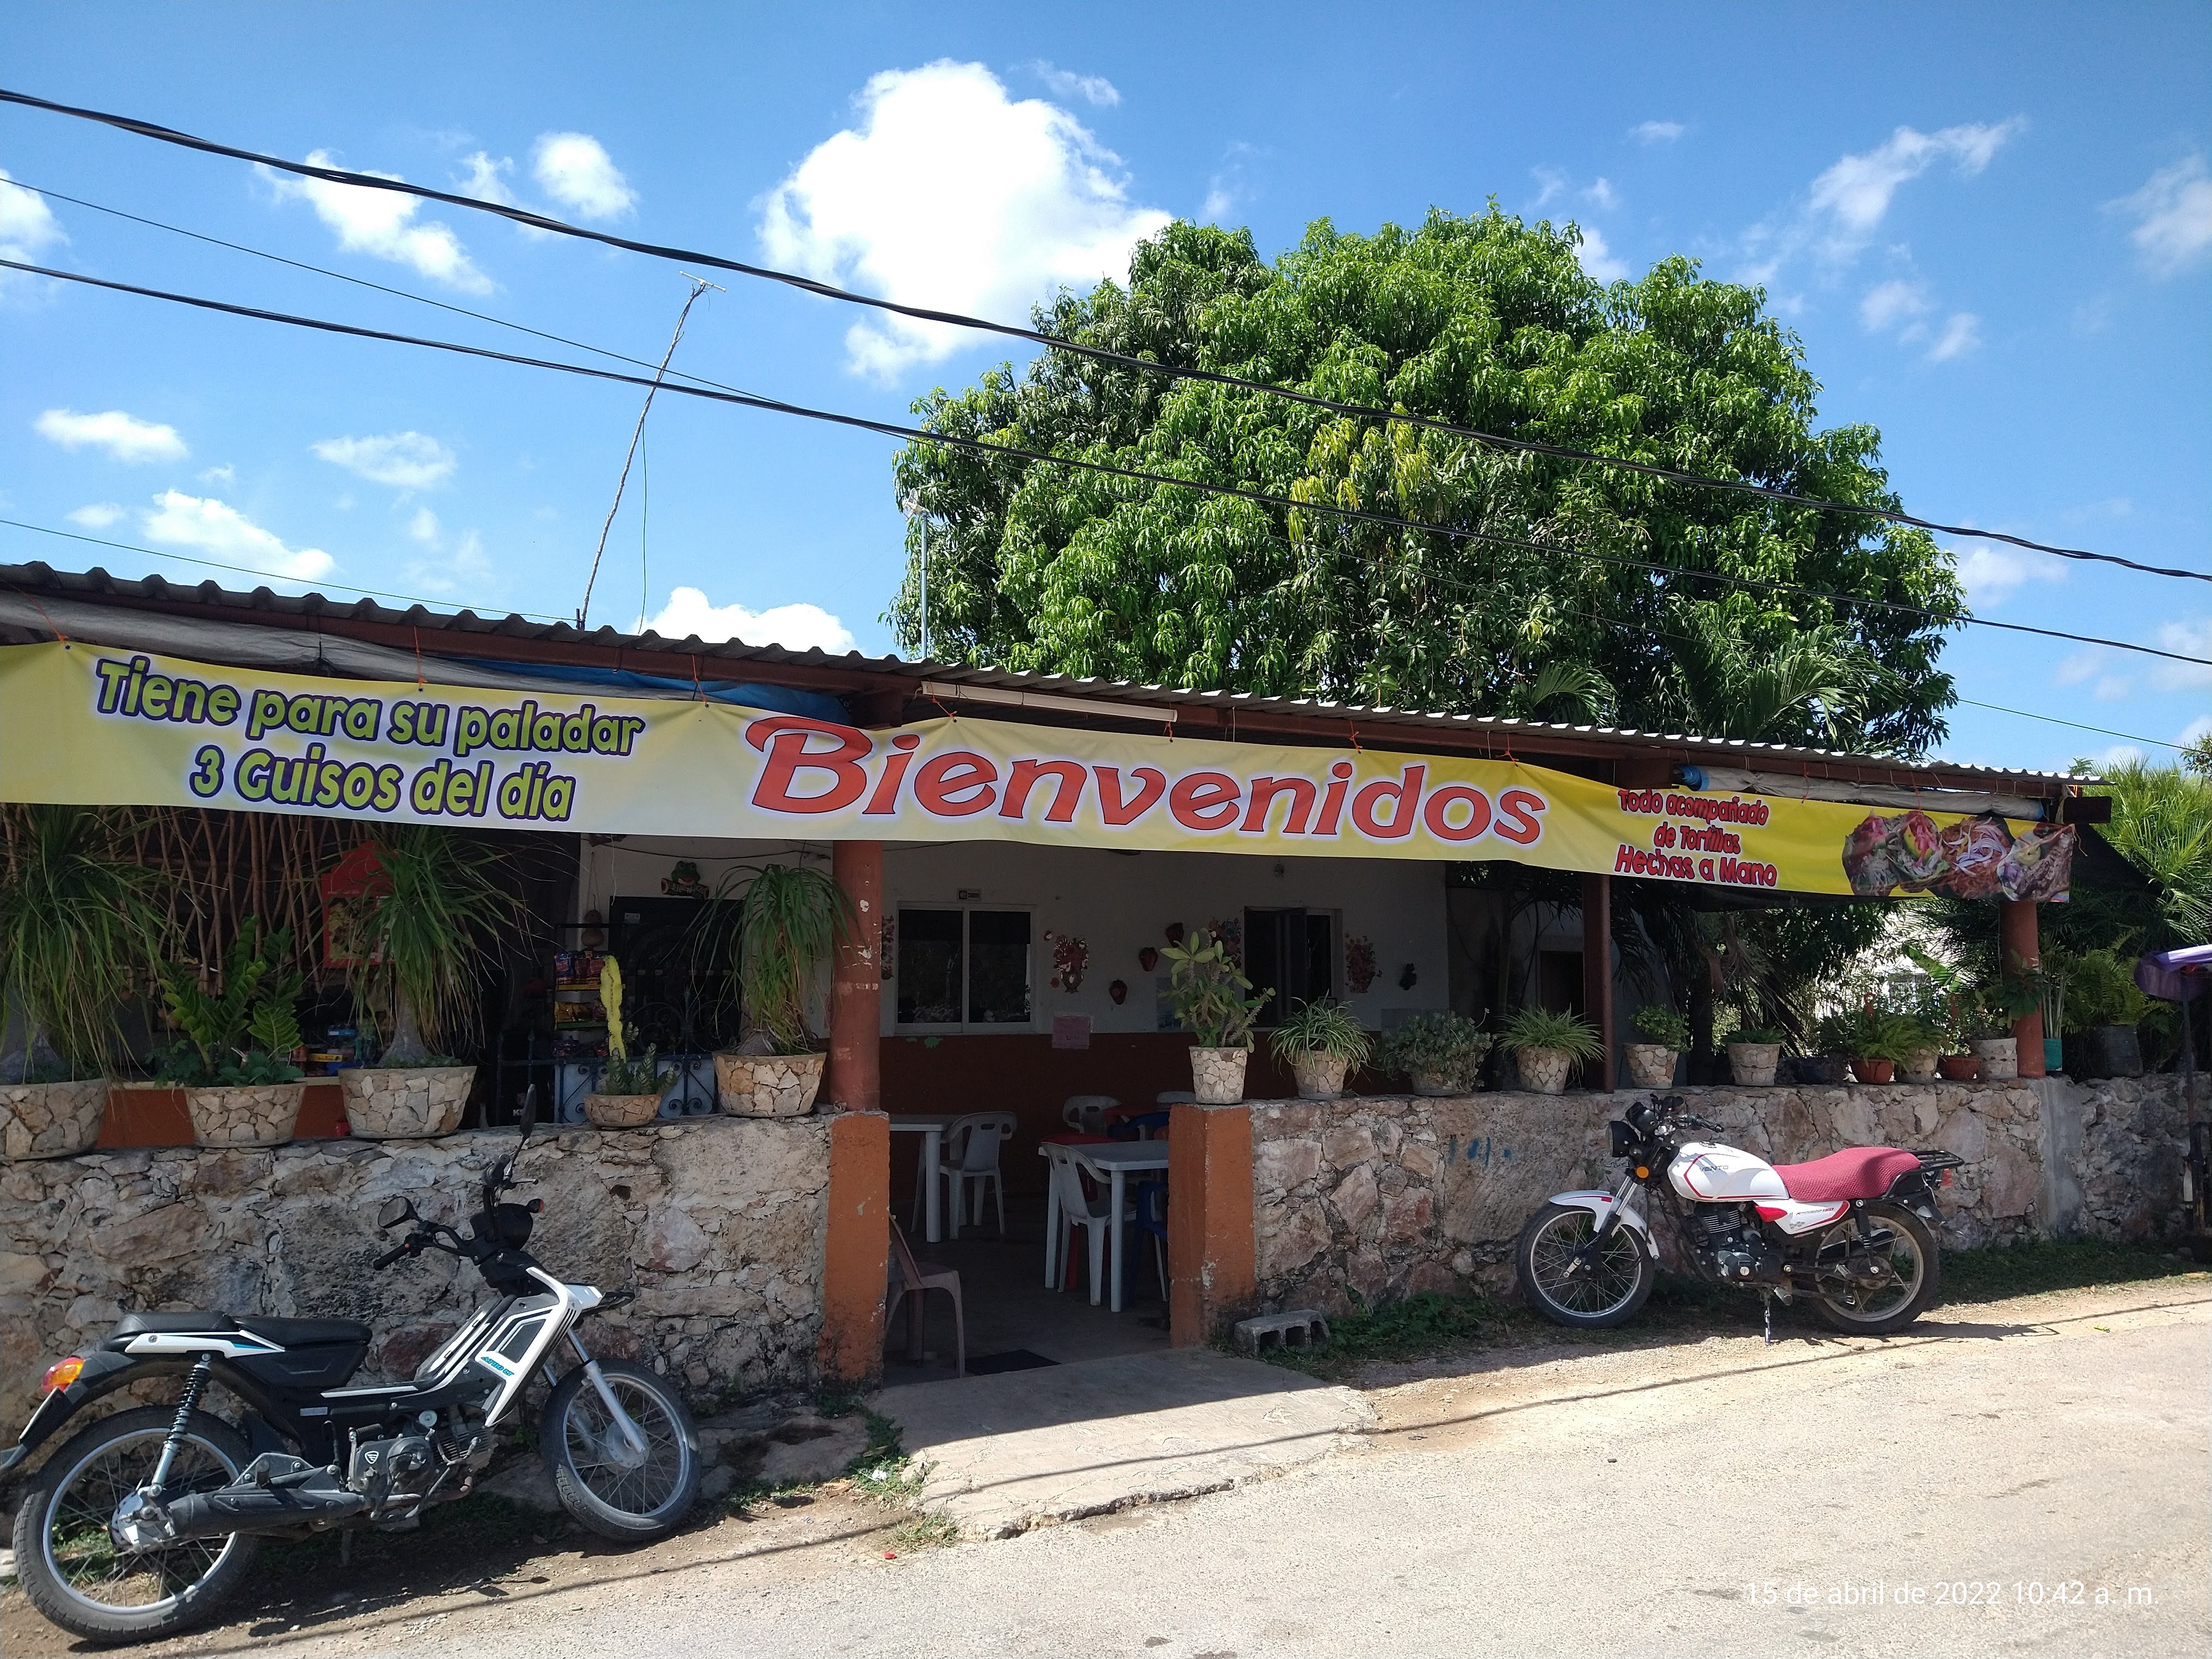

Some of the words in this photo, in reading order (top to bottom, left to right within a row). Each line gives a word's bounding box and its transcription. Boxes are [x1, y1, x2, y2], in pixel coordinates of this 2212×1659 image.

[96, 655, 242, 727] Tiene
[245, 689, 383, 742] para
[386, 700, 450, 747] su
[452, 700, 646, 758] paladar
[189, 744, 225, 798] 3
[234, 742, 404, 813] Guisos
[409, 758, 494, 817] del
[496, 760, 576, 821] día
[745, 716, 1546, 844] Bienvenidos
[1618, 789, 1663, 813] Todo
[1615, 844, 1695, 879] Hechas
[1698, 858, 1715, 881] a
[1719, 857, 1777, 887] Mano
[1653, 821, 1677, 848] de
[1680, 825, 1741, 854] Tortillas
